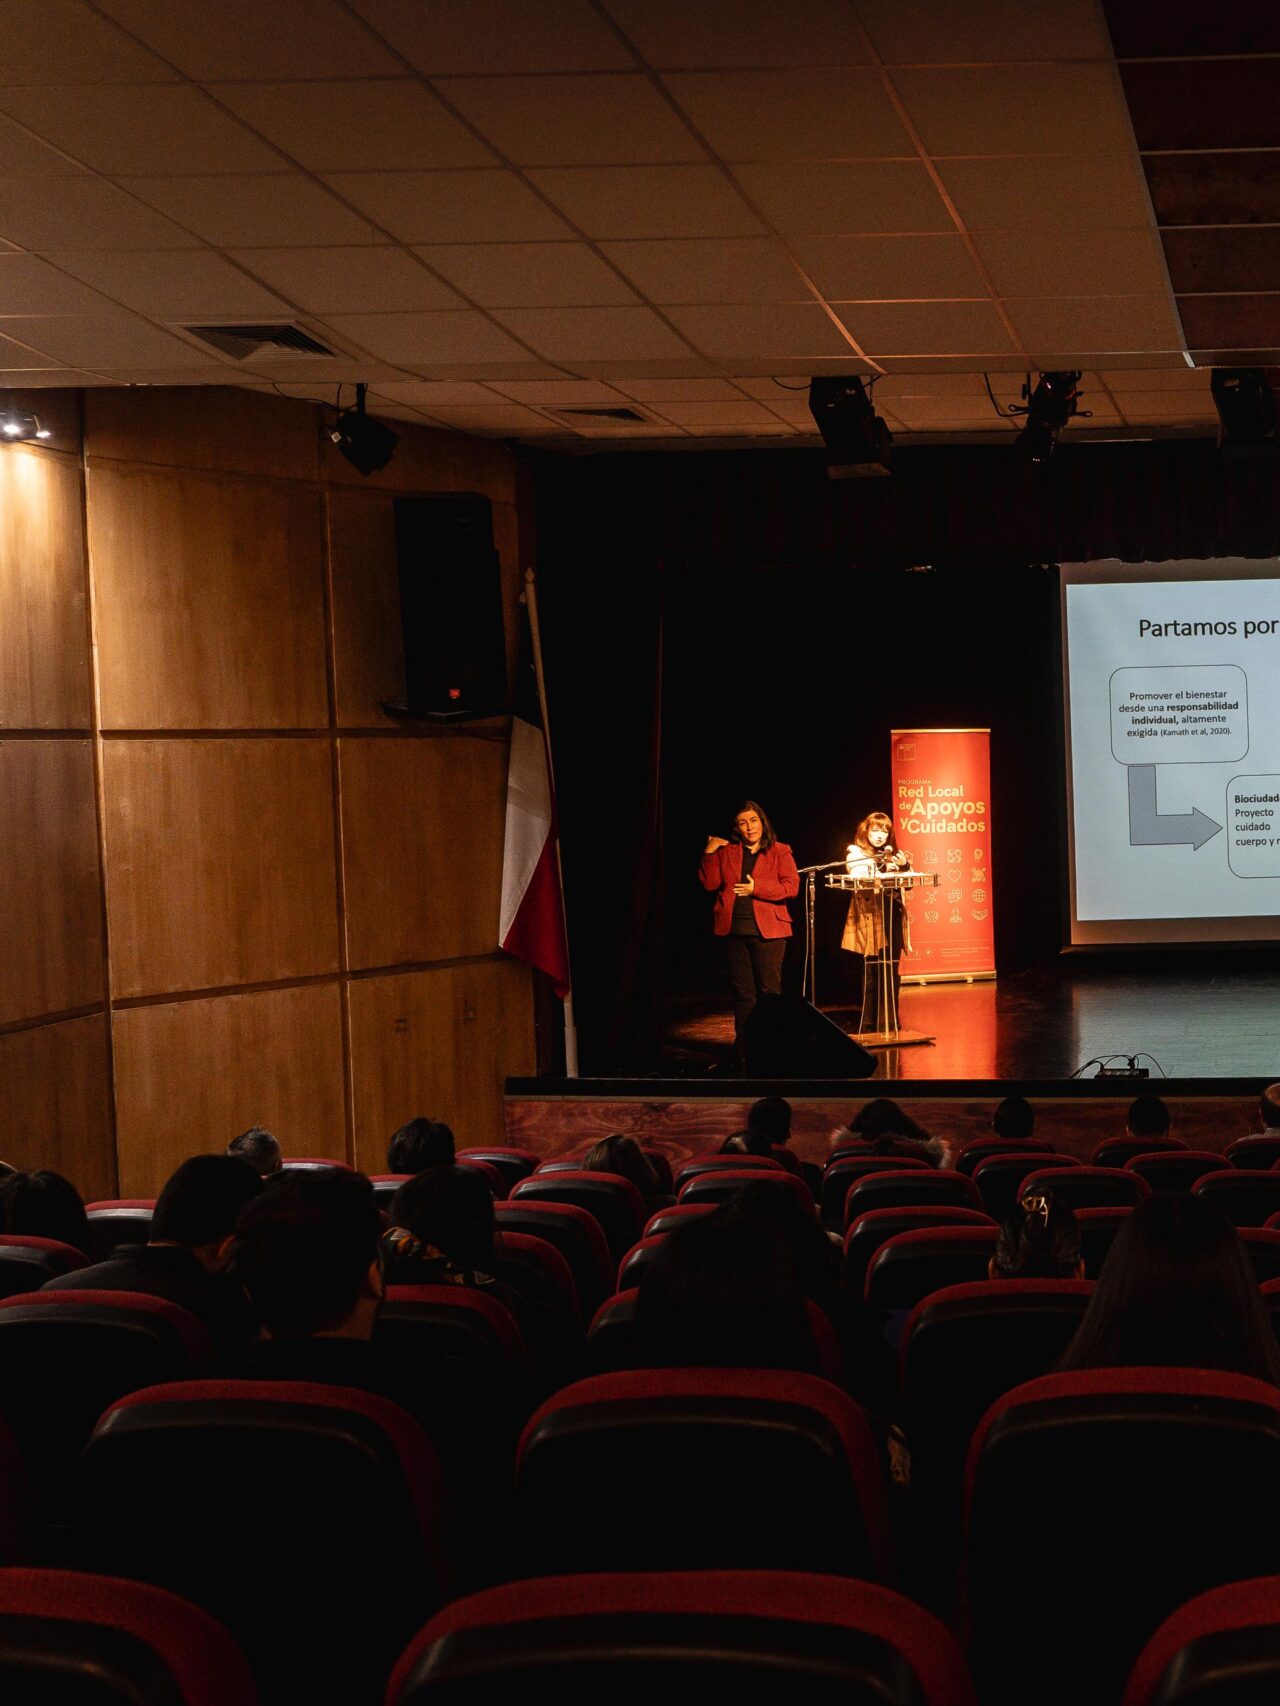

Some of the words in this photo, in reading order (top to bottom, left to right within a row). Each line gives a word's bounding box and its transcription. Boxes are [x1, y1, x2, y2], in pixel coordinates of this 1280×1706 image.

[1139, 618, 1237, 638] Partamos
[1244, 619, 1279, 639] por
[1129, 692, 1173, 700] Promover
[1175, 691, 1183, 699] el
[1185, 691, 1227, 699] bienestar
[1119, 704, 1145, 712] desde
[1166, 701, 1239, 713] responsabilidad
[1131, 716, 1179, 725] individual,
[1181, 715, 1227, 724] altamente
[1127, 728, 1158, 739] exigida
[1160, 728, 1189, 737] (Kamath
[1200, 727, 1208, 736] al,
[1210, 727, 1232, 735] 2020).
[898, 786, 924, 798] Red
[928, 784, 964, 798] Local
[899, 801, 912, 810] de
[910, 798, 986, 820] Apoyos
[1235, 808, 1274, 818] Proyecto
[900, 817, 909, 831] y
[907, 818, 986, 834] Cuidados
[1235, 822, 1271, 831] cuidado
[1235, 838, 1267, 847] cuerpo
[1269, 839, 1275, 847] y
